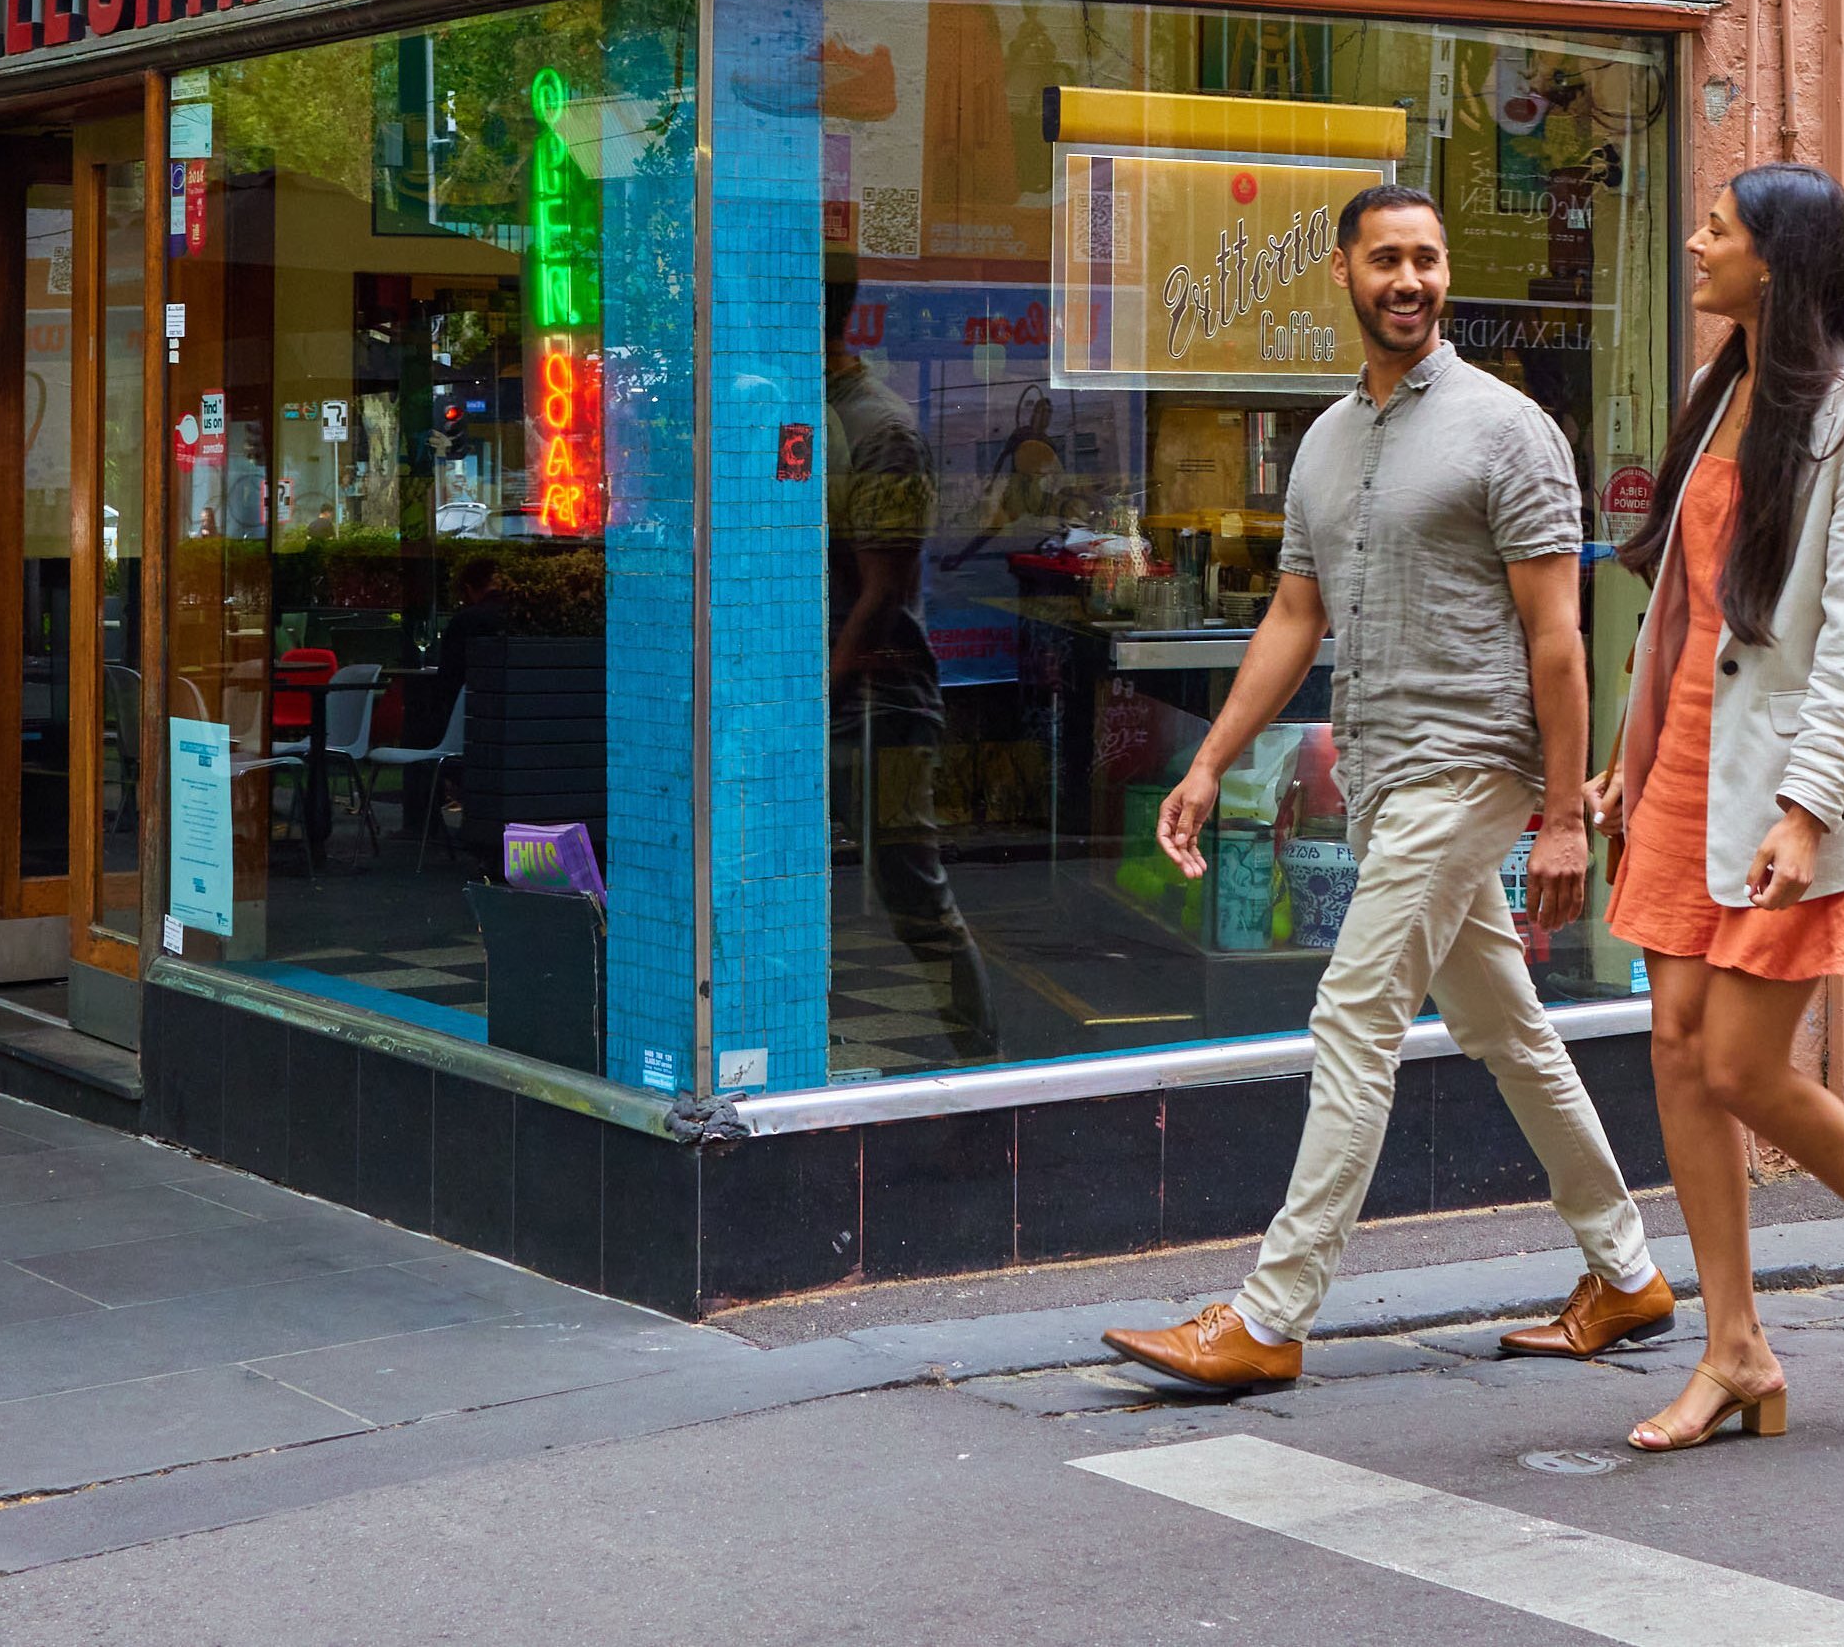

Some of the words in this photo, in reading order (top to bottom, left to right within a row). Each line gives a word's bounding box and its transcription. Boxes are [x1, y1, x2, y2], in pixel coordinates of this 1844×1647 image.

[1163, 204, 1338, 359] Vittoria
[1261, 310, 1335, 362] Coffee
[203, 401, 218, 414] find
[203, 418, 212, 429] us
[213, 418, 223, 429] on
